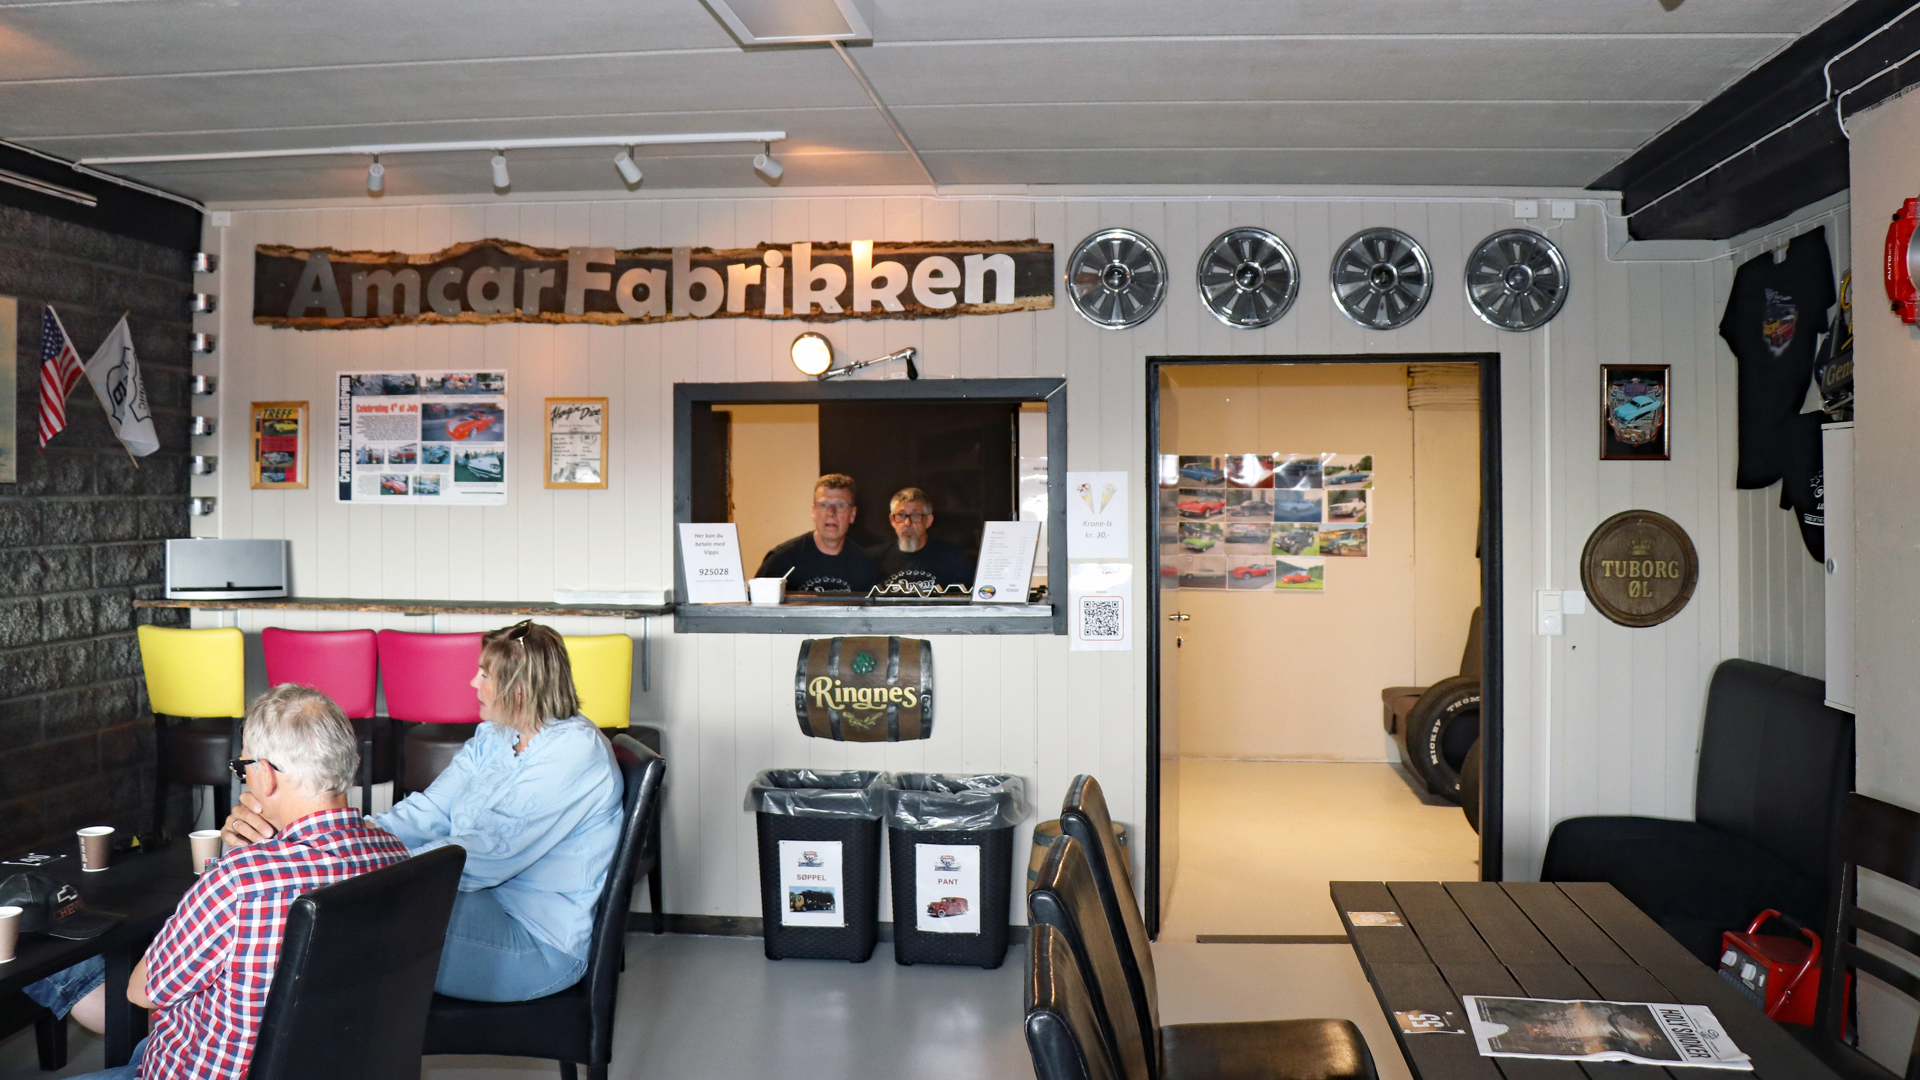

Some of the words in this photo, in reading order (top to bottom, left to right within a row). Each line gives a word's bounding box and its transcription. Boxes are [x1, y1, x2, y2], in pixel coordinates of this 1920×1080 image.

[288, 240, 1016, 318] AmcarFabrikken
[263, 408, 293, 418] TREFF
[356, 404, 388, 413] Celebrating
[399, 404, 405, 412] of
[406, 404, 419, 413] July
[580, 406, 601, 420] Dice
[340, 425, 352, 450] Night
[340, 452, 351, 482] Cruise
[699, 568, 729, 576] 925028
[1601, 559, 1680, 579] TUBORG
[1628, 581, 1653, 599] ØL
[809, 676, 917, 711] Ringnes
[1446, 696, 1481, 712] THOM
[1429, 718, 1441, 765] MICKEY
[1407, 1013, 1445, 1028] 55
[1659, 1009, 1689, 1028] HOLY
[1672, 1027, 1711, 1059] SMOKER
